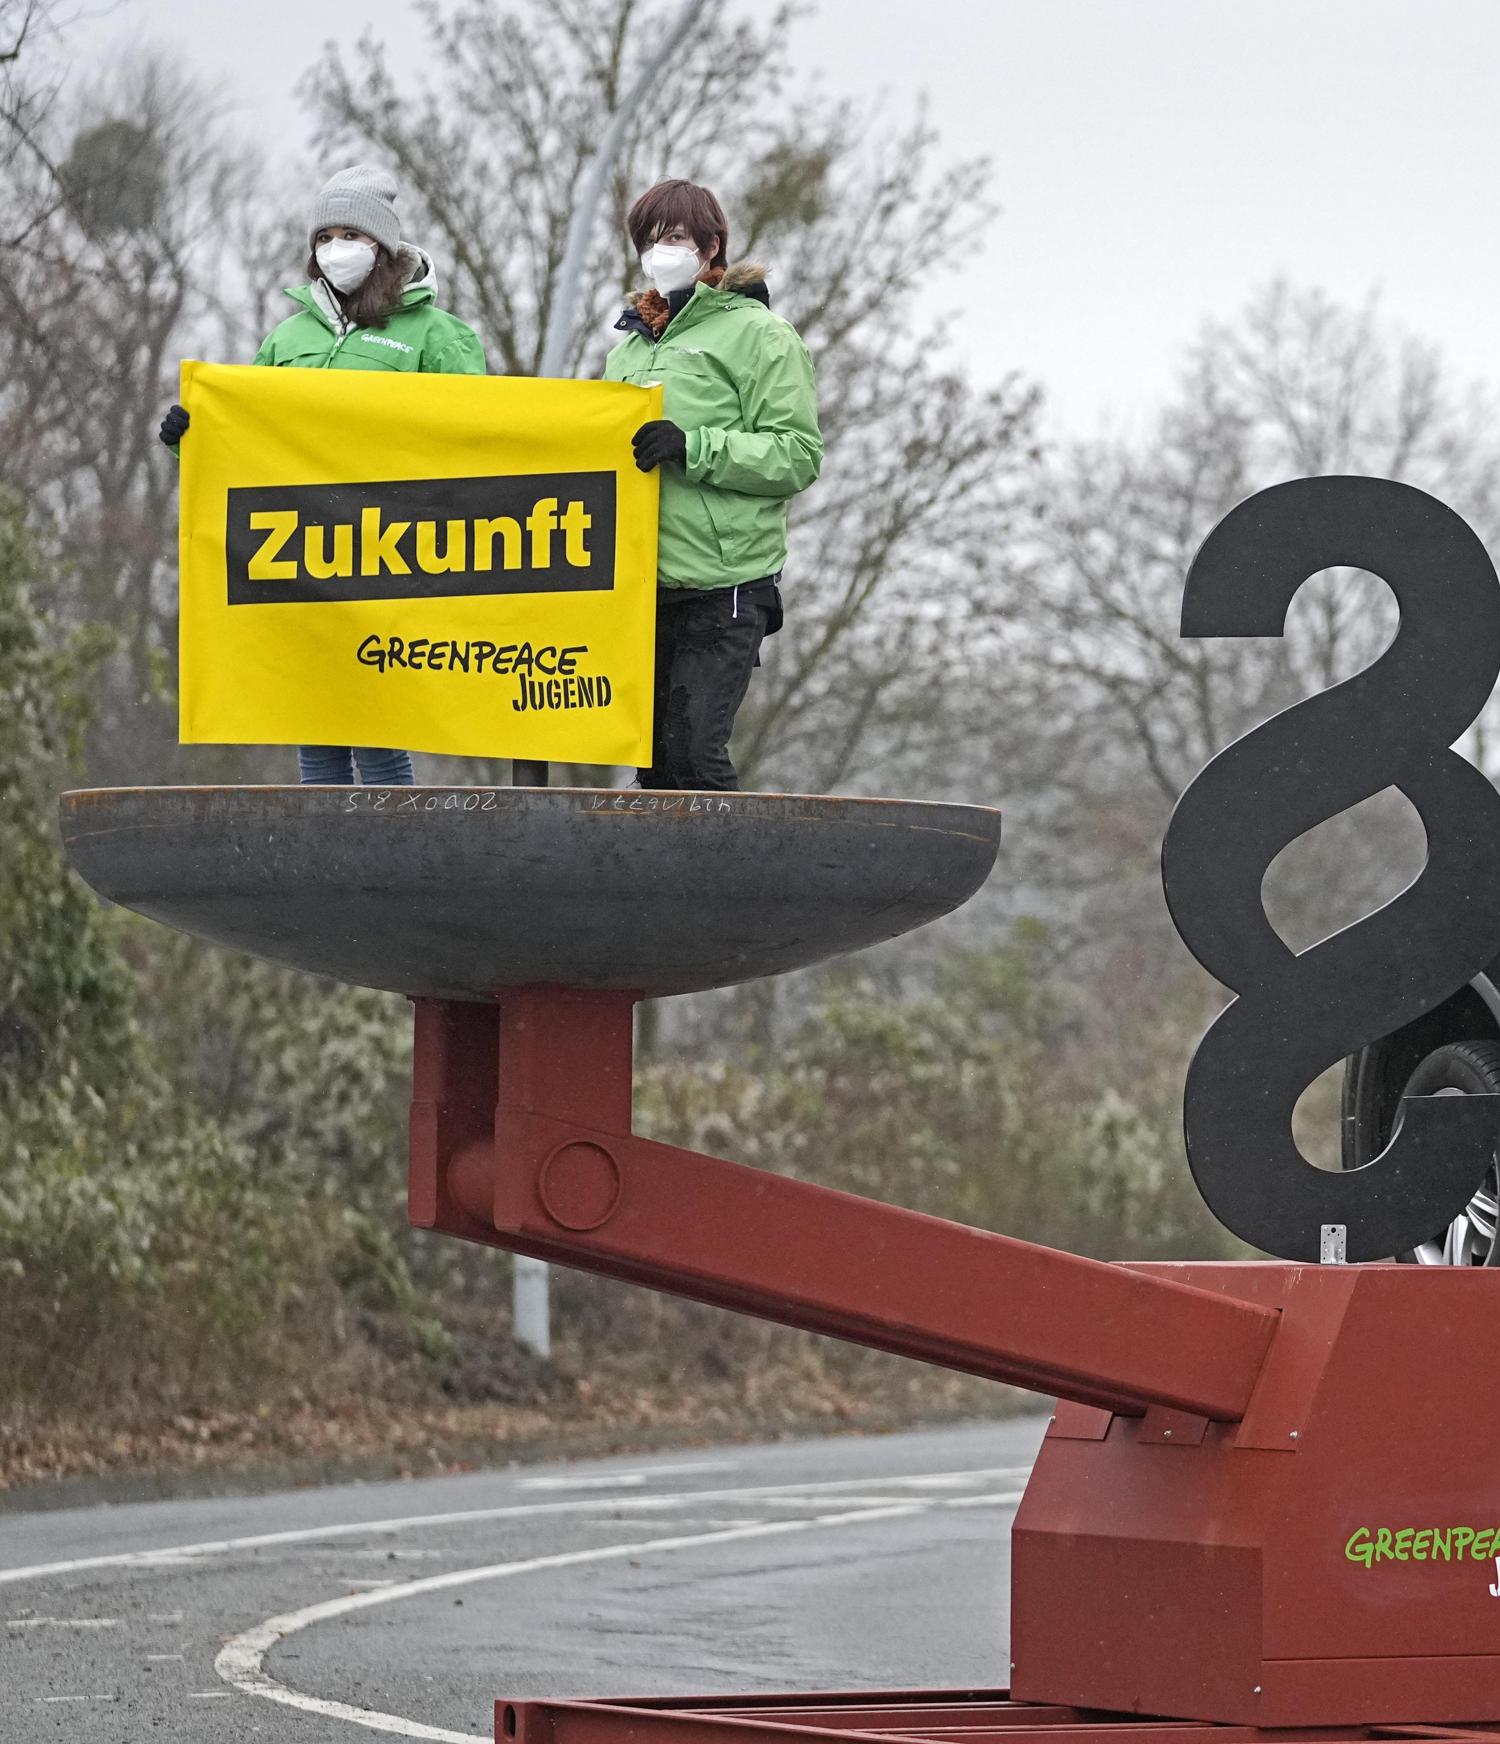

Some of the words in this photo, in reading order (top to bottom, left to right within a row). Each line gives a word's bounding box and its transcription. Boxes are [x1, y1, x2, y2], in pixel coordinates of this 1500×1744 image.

[247, 498, 592, 581] Zukunft
[356, 634, 588, 676] GREENPEACE
[512, 673, 612, 712] JUGEND
